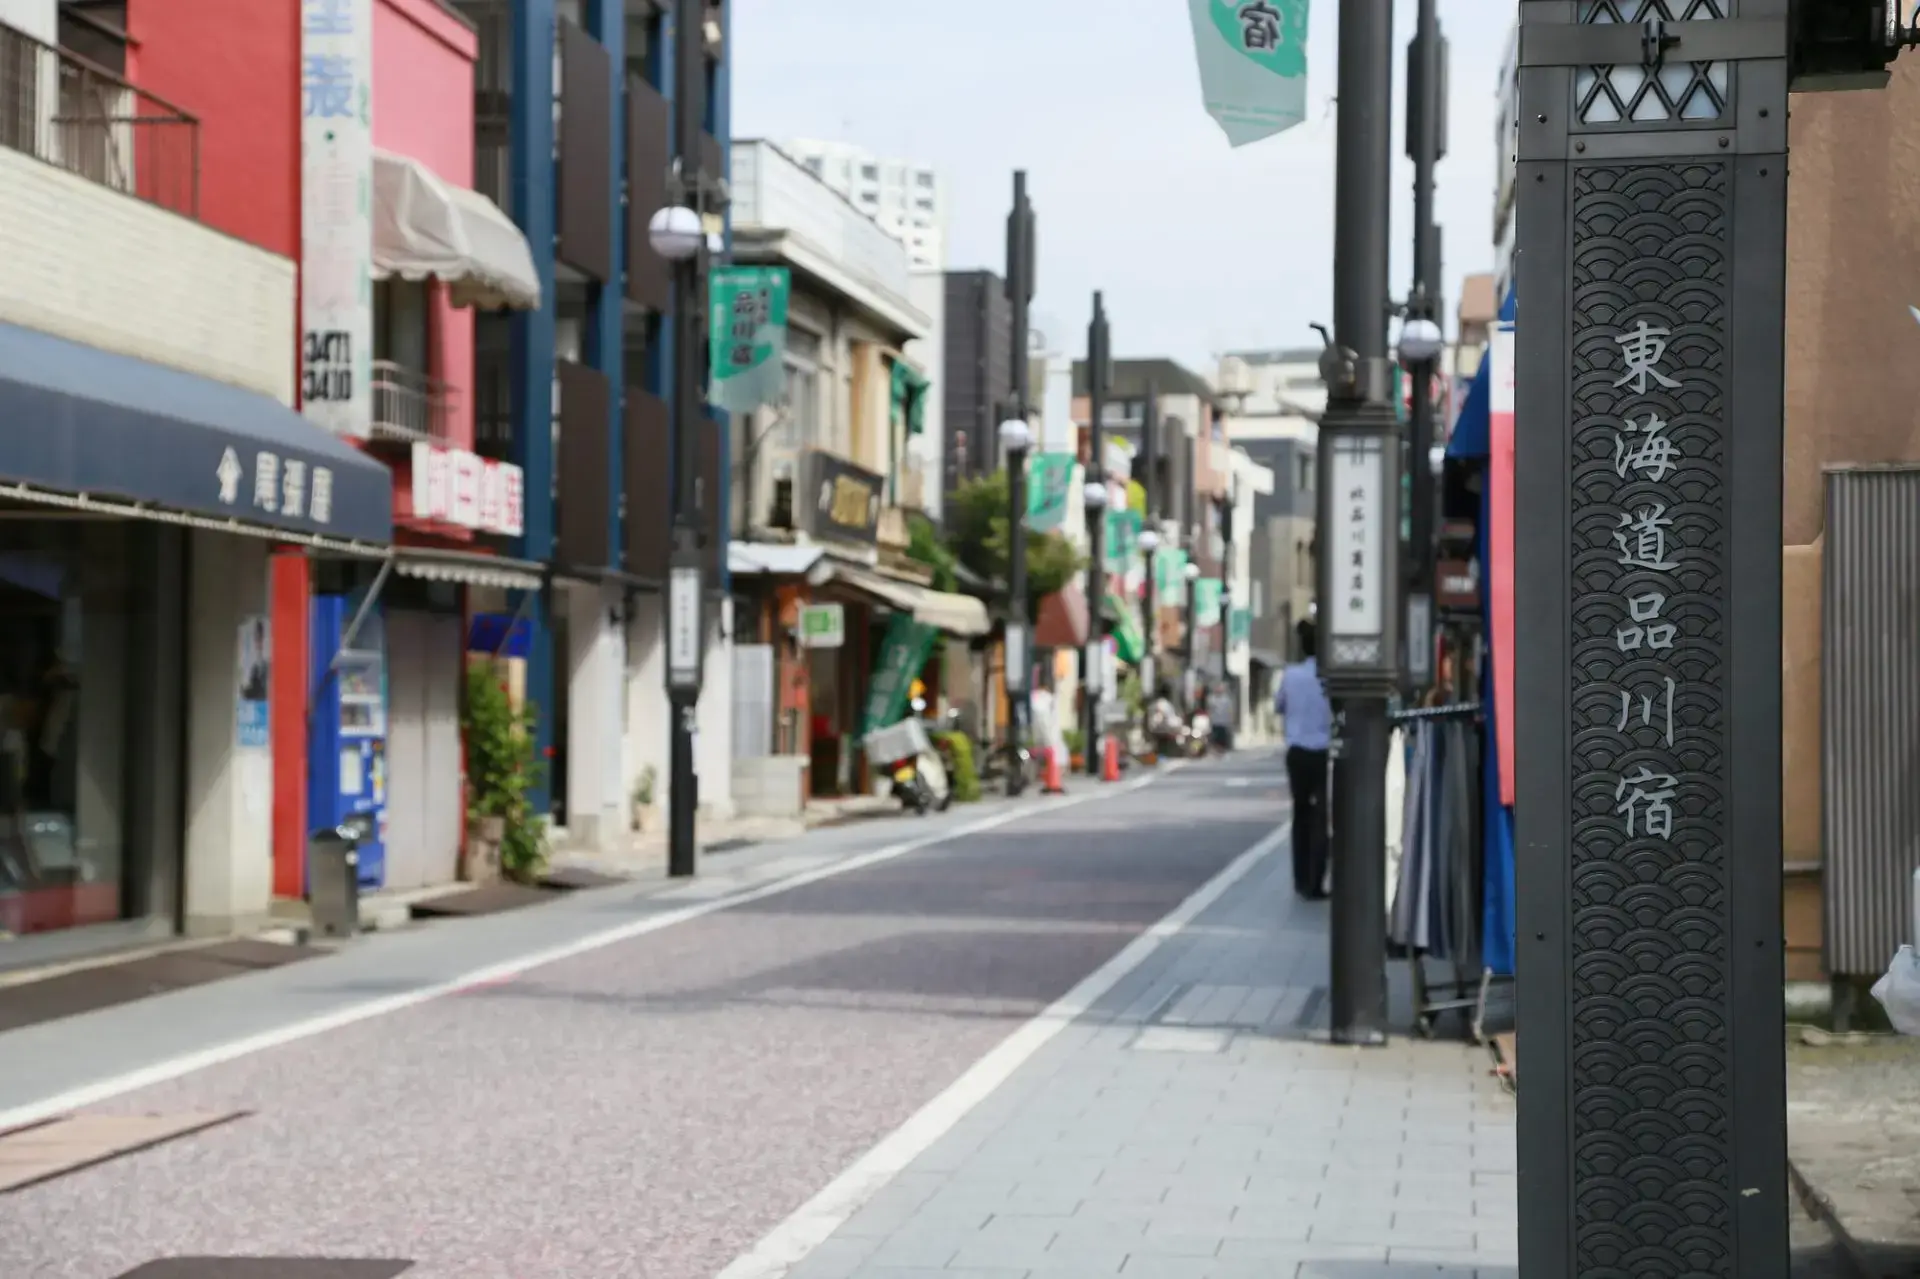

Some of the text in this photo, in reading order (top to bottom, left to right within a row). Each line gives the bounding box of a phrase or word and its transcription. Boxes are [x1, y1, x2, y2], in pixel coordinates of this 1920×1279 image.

[1239, 0, 1281, 50] 宿
[1613, 320, 1682, 840] 東海道品川宿
